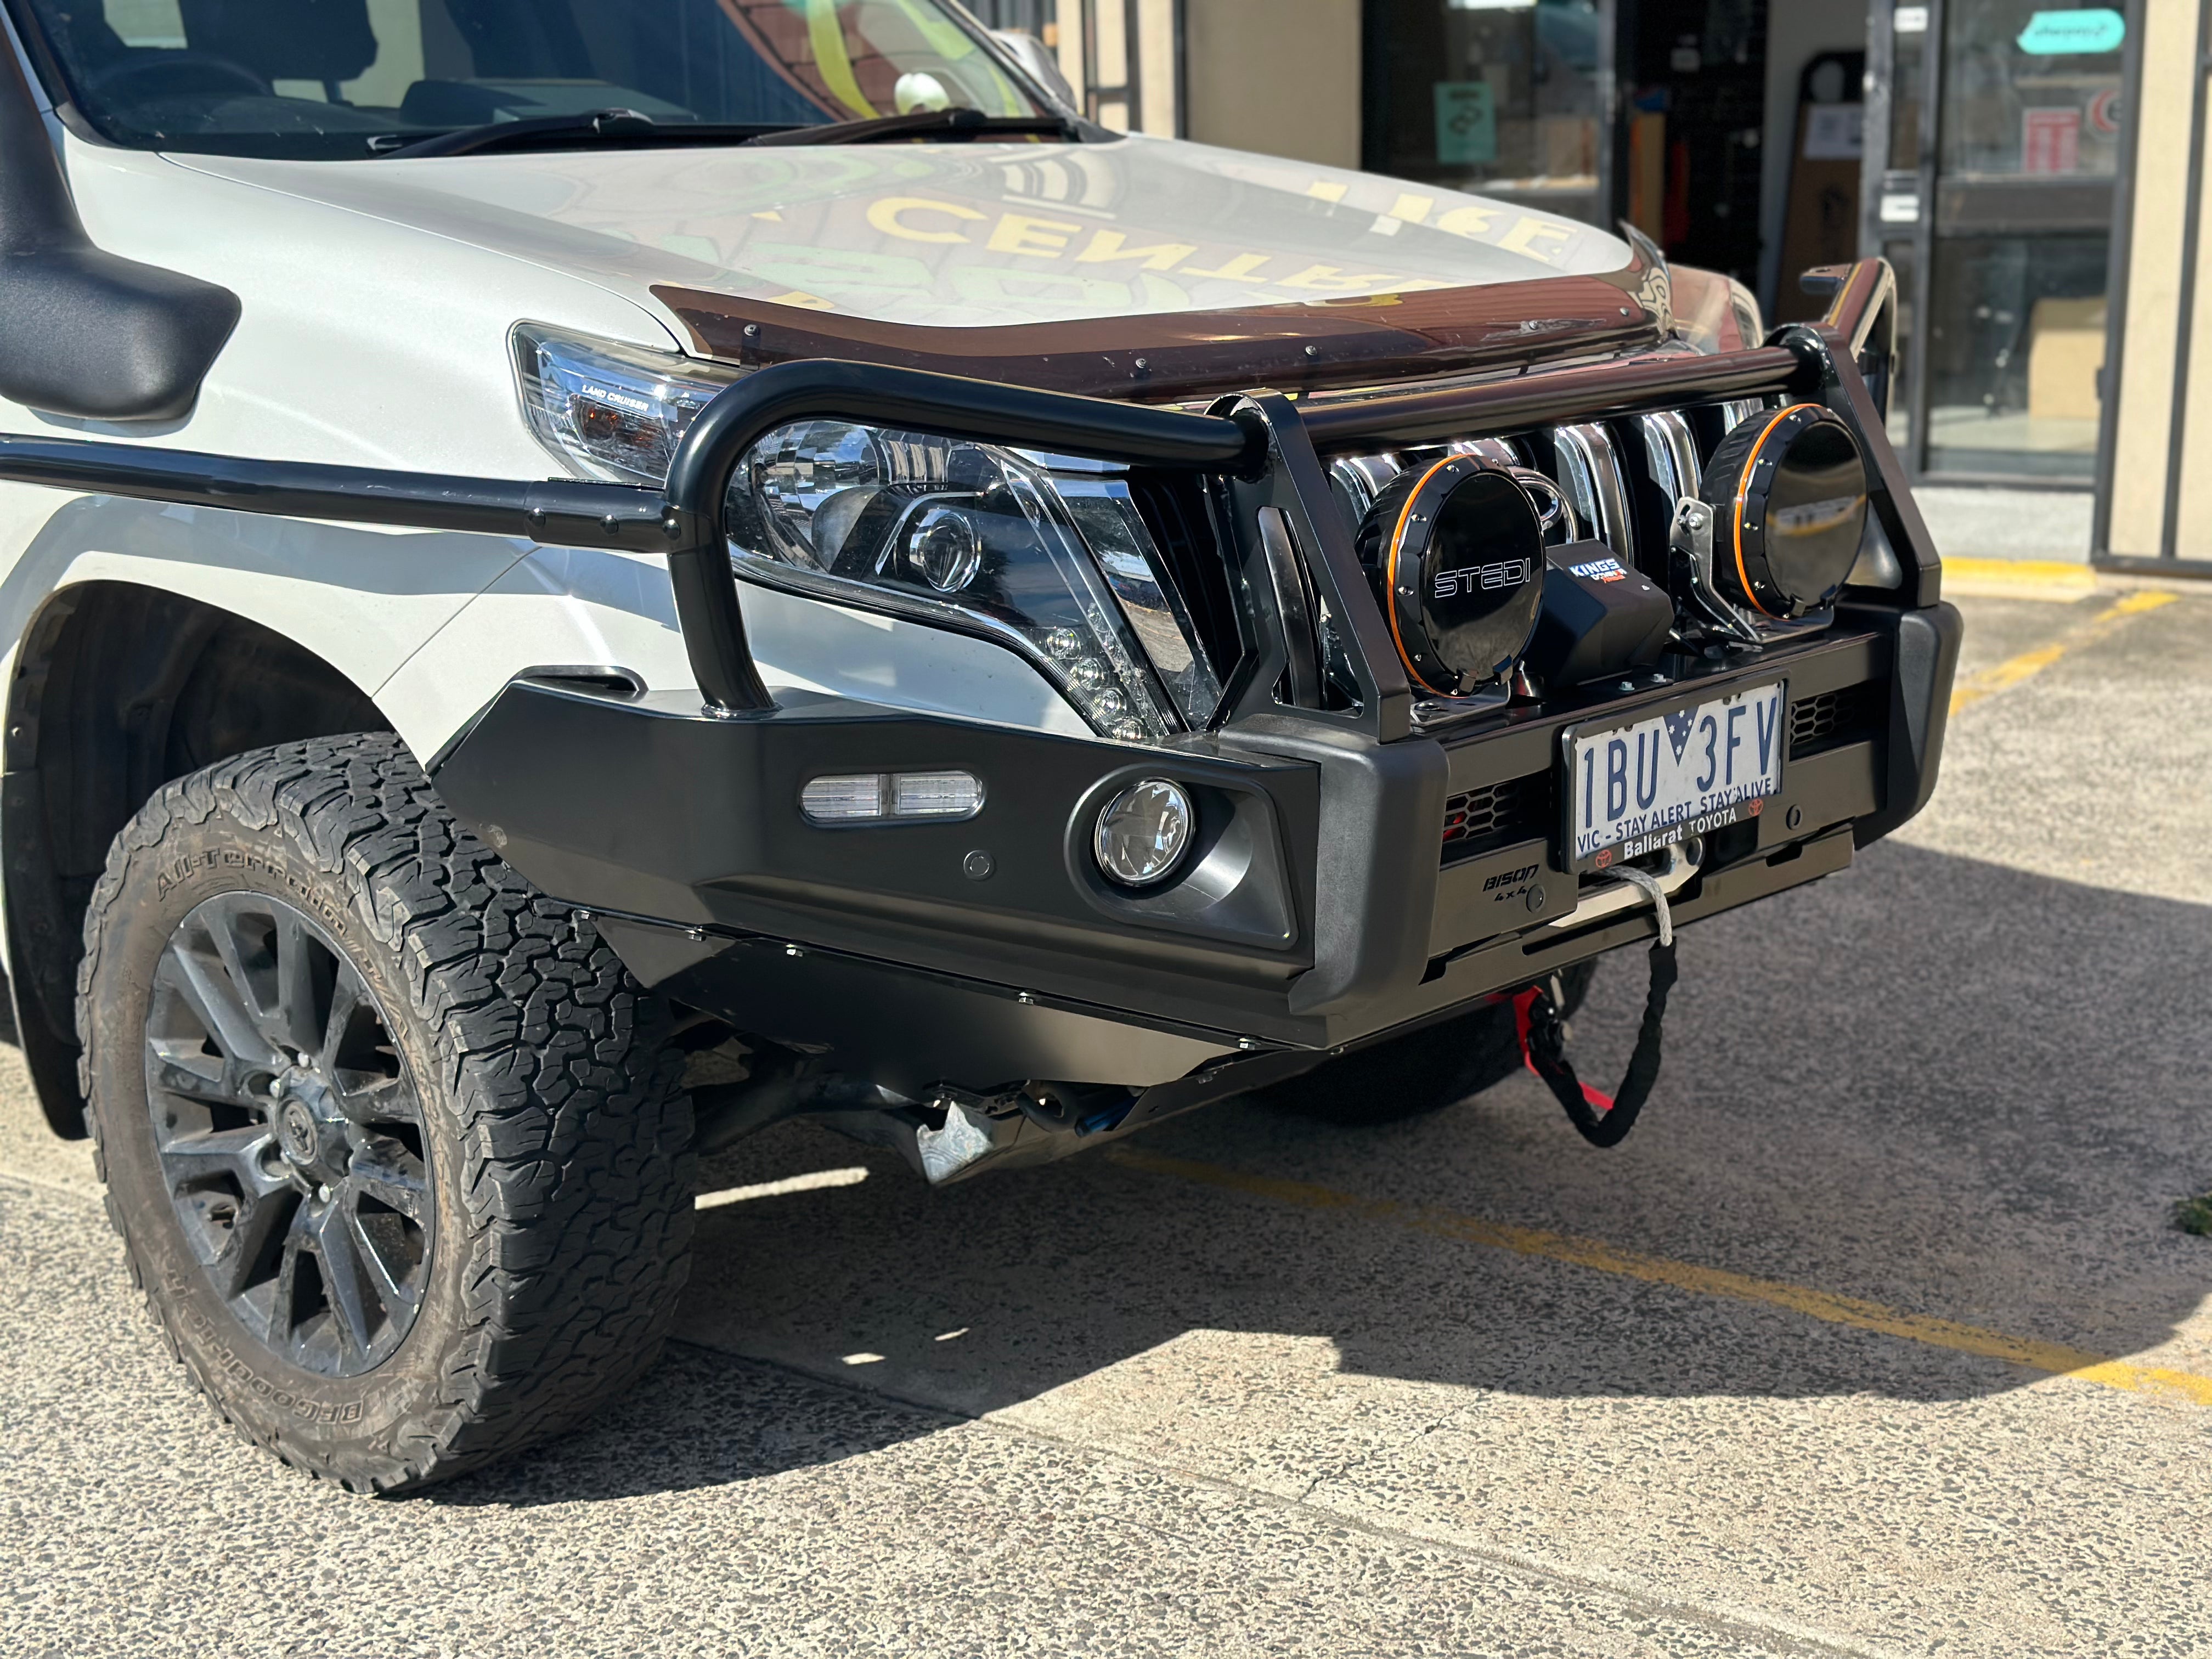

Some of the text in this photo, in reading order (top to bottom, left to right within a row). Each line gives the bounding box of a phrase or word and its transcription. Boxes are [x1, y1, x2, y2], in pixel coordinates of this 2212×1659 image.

[582, 385, 649, 411] LAND CRUISER
[1435, 557, 1530, 599] STEDI
[1568, 557, 1620, 577] KINGS
[1584, 697, 1777, 828] 1BU 3FV
[1578, 830, 1600, 852] VIC
[1616, 814, 1646, 840] STAY
[1651, 801, 1691, 829] ALERT
[1701, 789, 1731, 814] STAY
[1736, 777, 1771, 803] ALIVE
[1624, 808, 1736, 859] Ballarat TOYOTA
